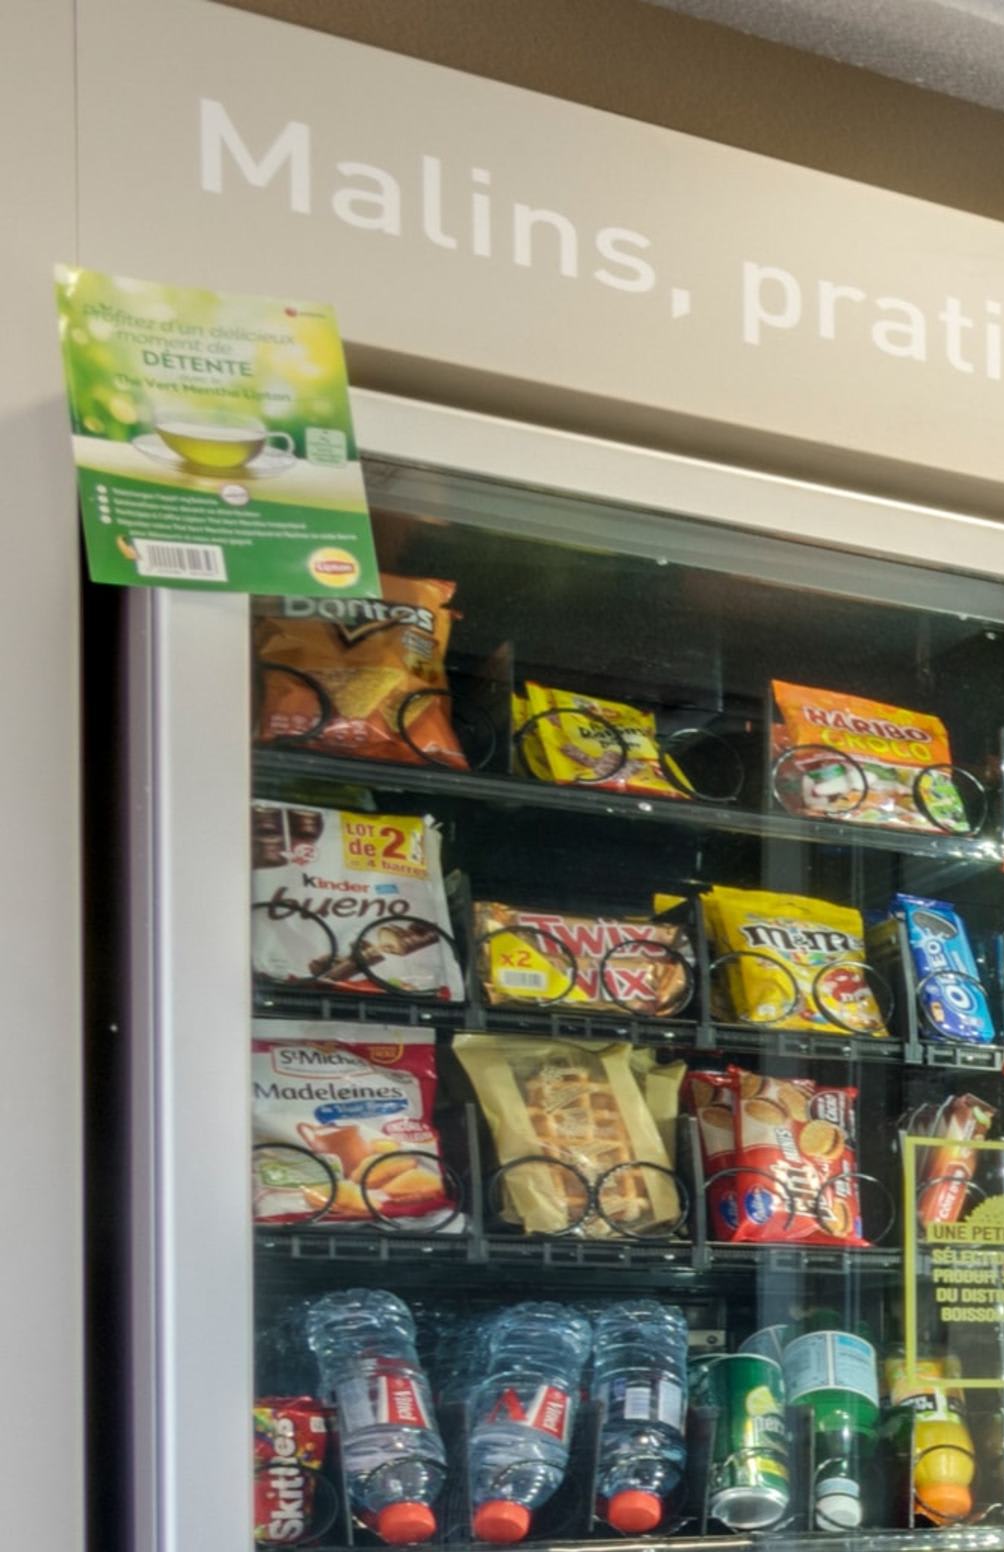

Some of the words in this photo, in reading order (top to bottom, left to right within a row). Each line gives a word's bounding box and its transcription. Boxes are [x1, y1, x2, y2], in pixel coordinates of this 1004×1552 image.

[201, 98, 691, 318] Malins,
[141, 348, 255, 377] DÉTENTE
[284, 597, 433, 633] Doritos
[803, 706, 932, 745] HARIBO
[346, 823, 375, 837] LOT
[349, 839, 376, 857] de
[380, 827, 407, 861] 2
[267, 887, 410, 921] bueno
[253, 1083, 403, 1101] Madeleines
[933, 1225, 967, 1240] UNE
[936, 1287, 958, 1302] DU
[268, 1417, 306, 1540] Skittles
